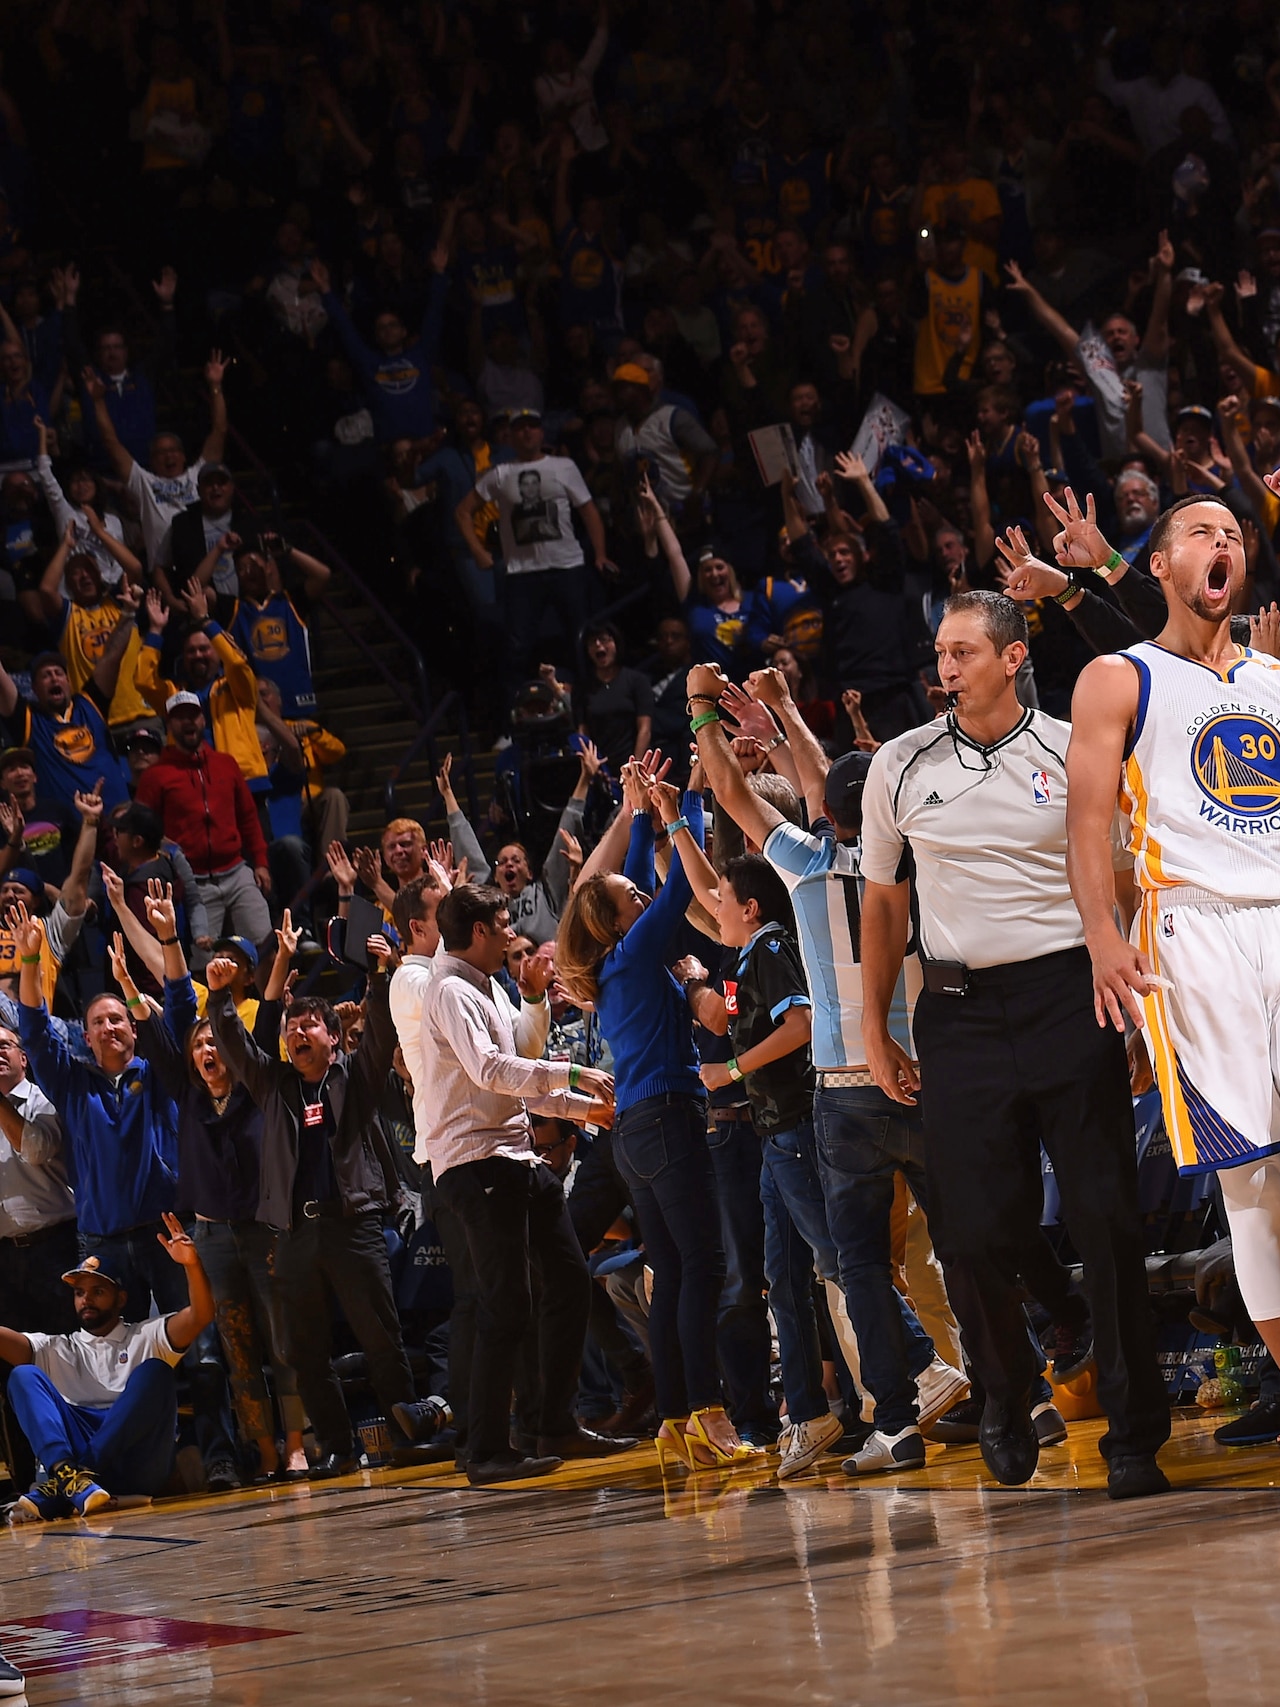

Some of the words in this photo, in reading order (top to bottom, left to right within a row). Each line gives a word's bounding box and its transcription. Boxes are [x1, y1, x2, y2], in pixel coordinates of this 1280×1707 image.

[266, 625, 282, 636] 30
[1187, 703, 1241, 736] GOLDEN
[1239, 732, 1277, 761] 30
